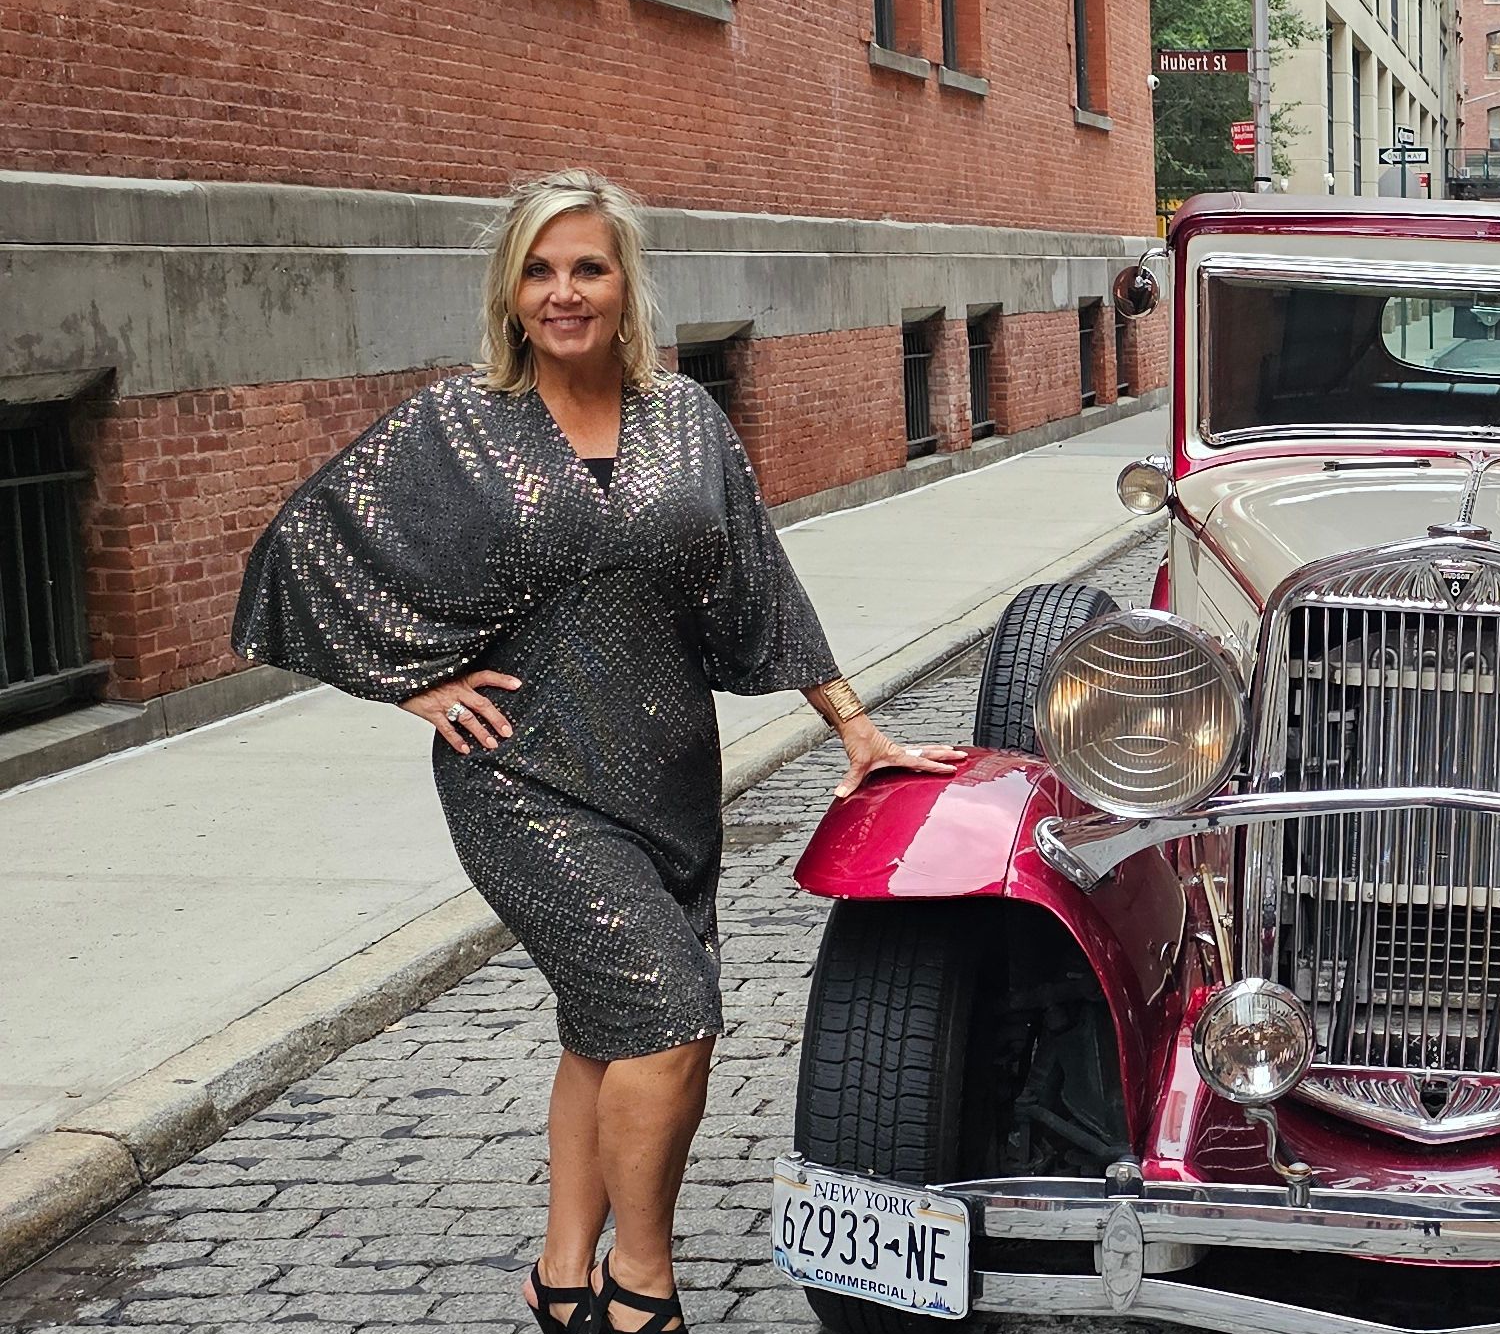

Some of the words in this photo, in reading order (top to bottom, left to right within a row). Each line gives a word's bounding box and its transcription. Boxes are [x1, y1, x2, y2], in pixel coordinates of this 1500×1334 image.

[1160, 54, 1208, 71] Hubert
[1213, 54, 1227, 71] St
[1450, 581, 1461, 597] 8
[812, 1179, 861, 1206] NEW
[863, 1189, 916, 1219] YORK
[814, 1268, 908, 1301] COMMERCIAL
